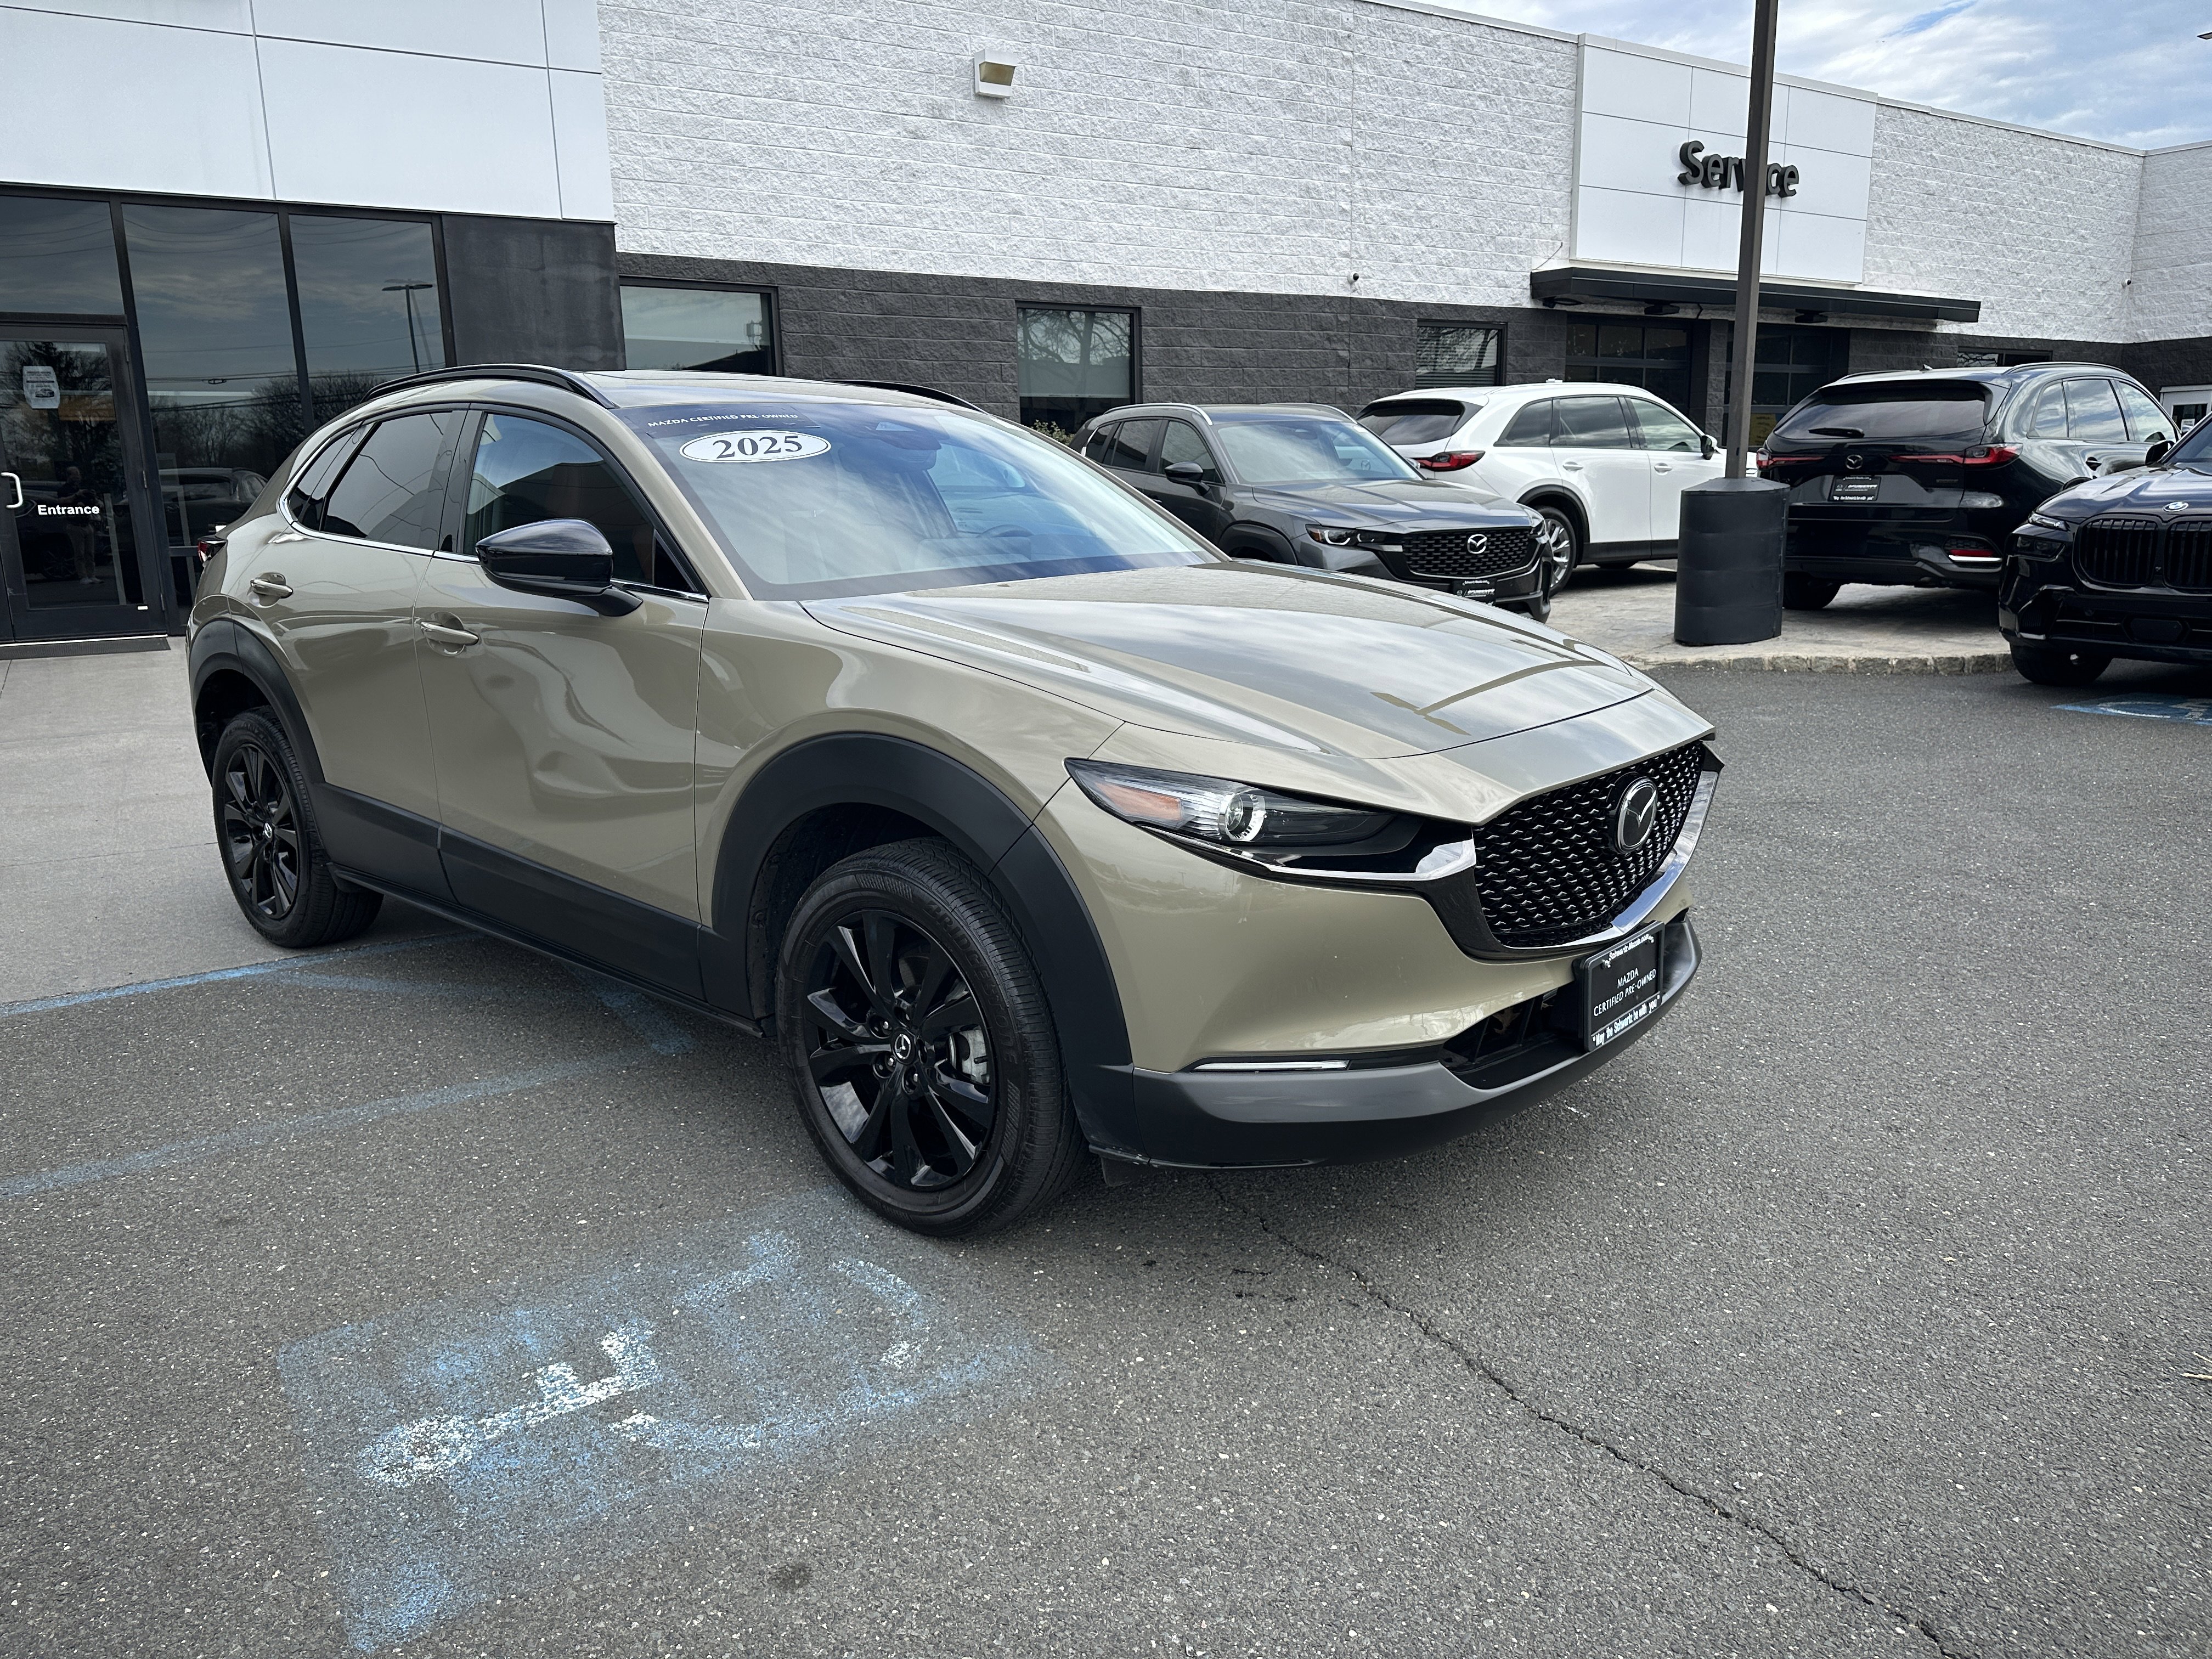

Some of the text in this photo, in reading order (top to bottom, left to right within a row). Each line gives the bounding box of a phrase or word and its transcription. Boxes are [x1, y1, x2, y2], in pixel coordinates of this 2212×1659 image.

[1678, 140, 1799, 198] Serce
[648, 419, 689, 427] MAZDA
[690, 414, 738, 422] CERTIFIED
[713, 435, 802, 459] 2025
[37, 504, 100, 515] Entrance
[1617, 967, 1639, 989] MAZDA
[1593, 968, 1656, 1017] CERTIFIED PRE-OWNED
[1614, 1013, 1633, 1034] Schwartz
[1633, 1009, 1639, 1021] be
[1639, 1003, 1647, 1018] with
